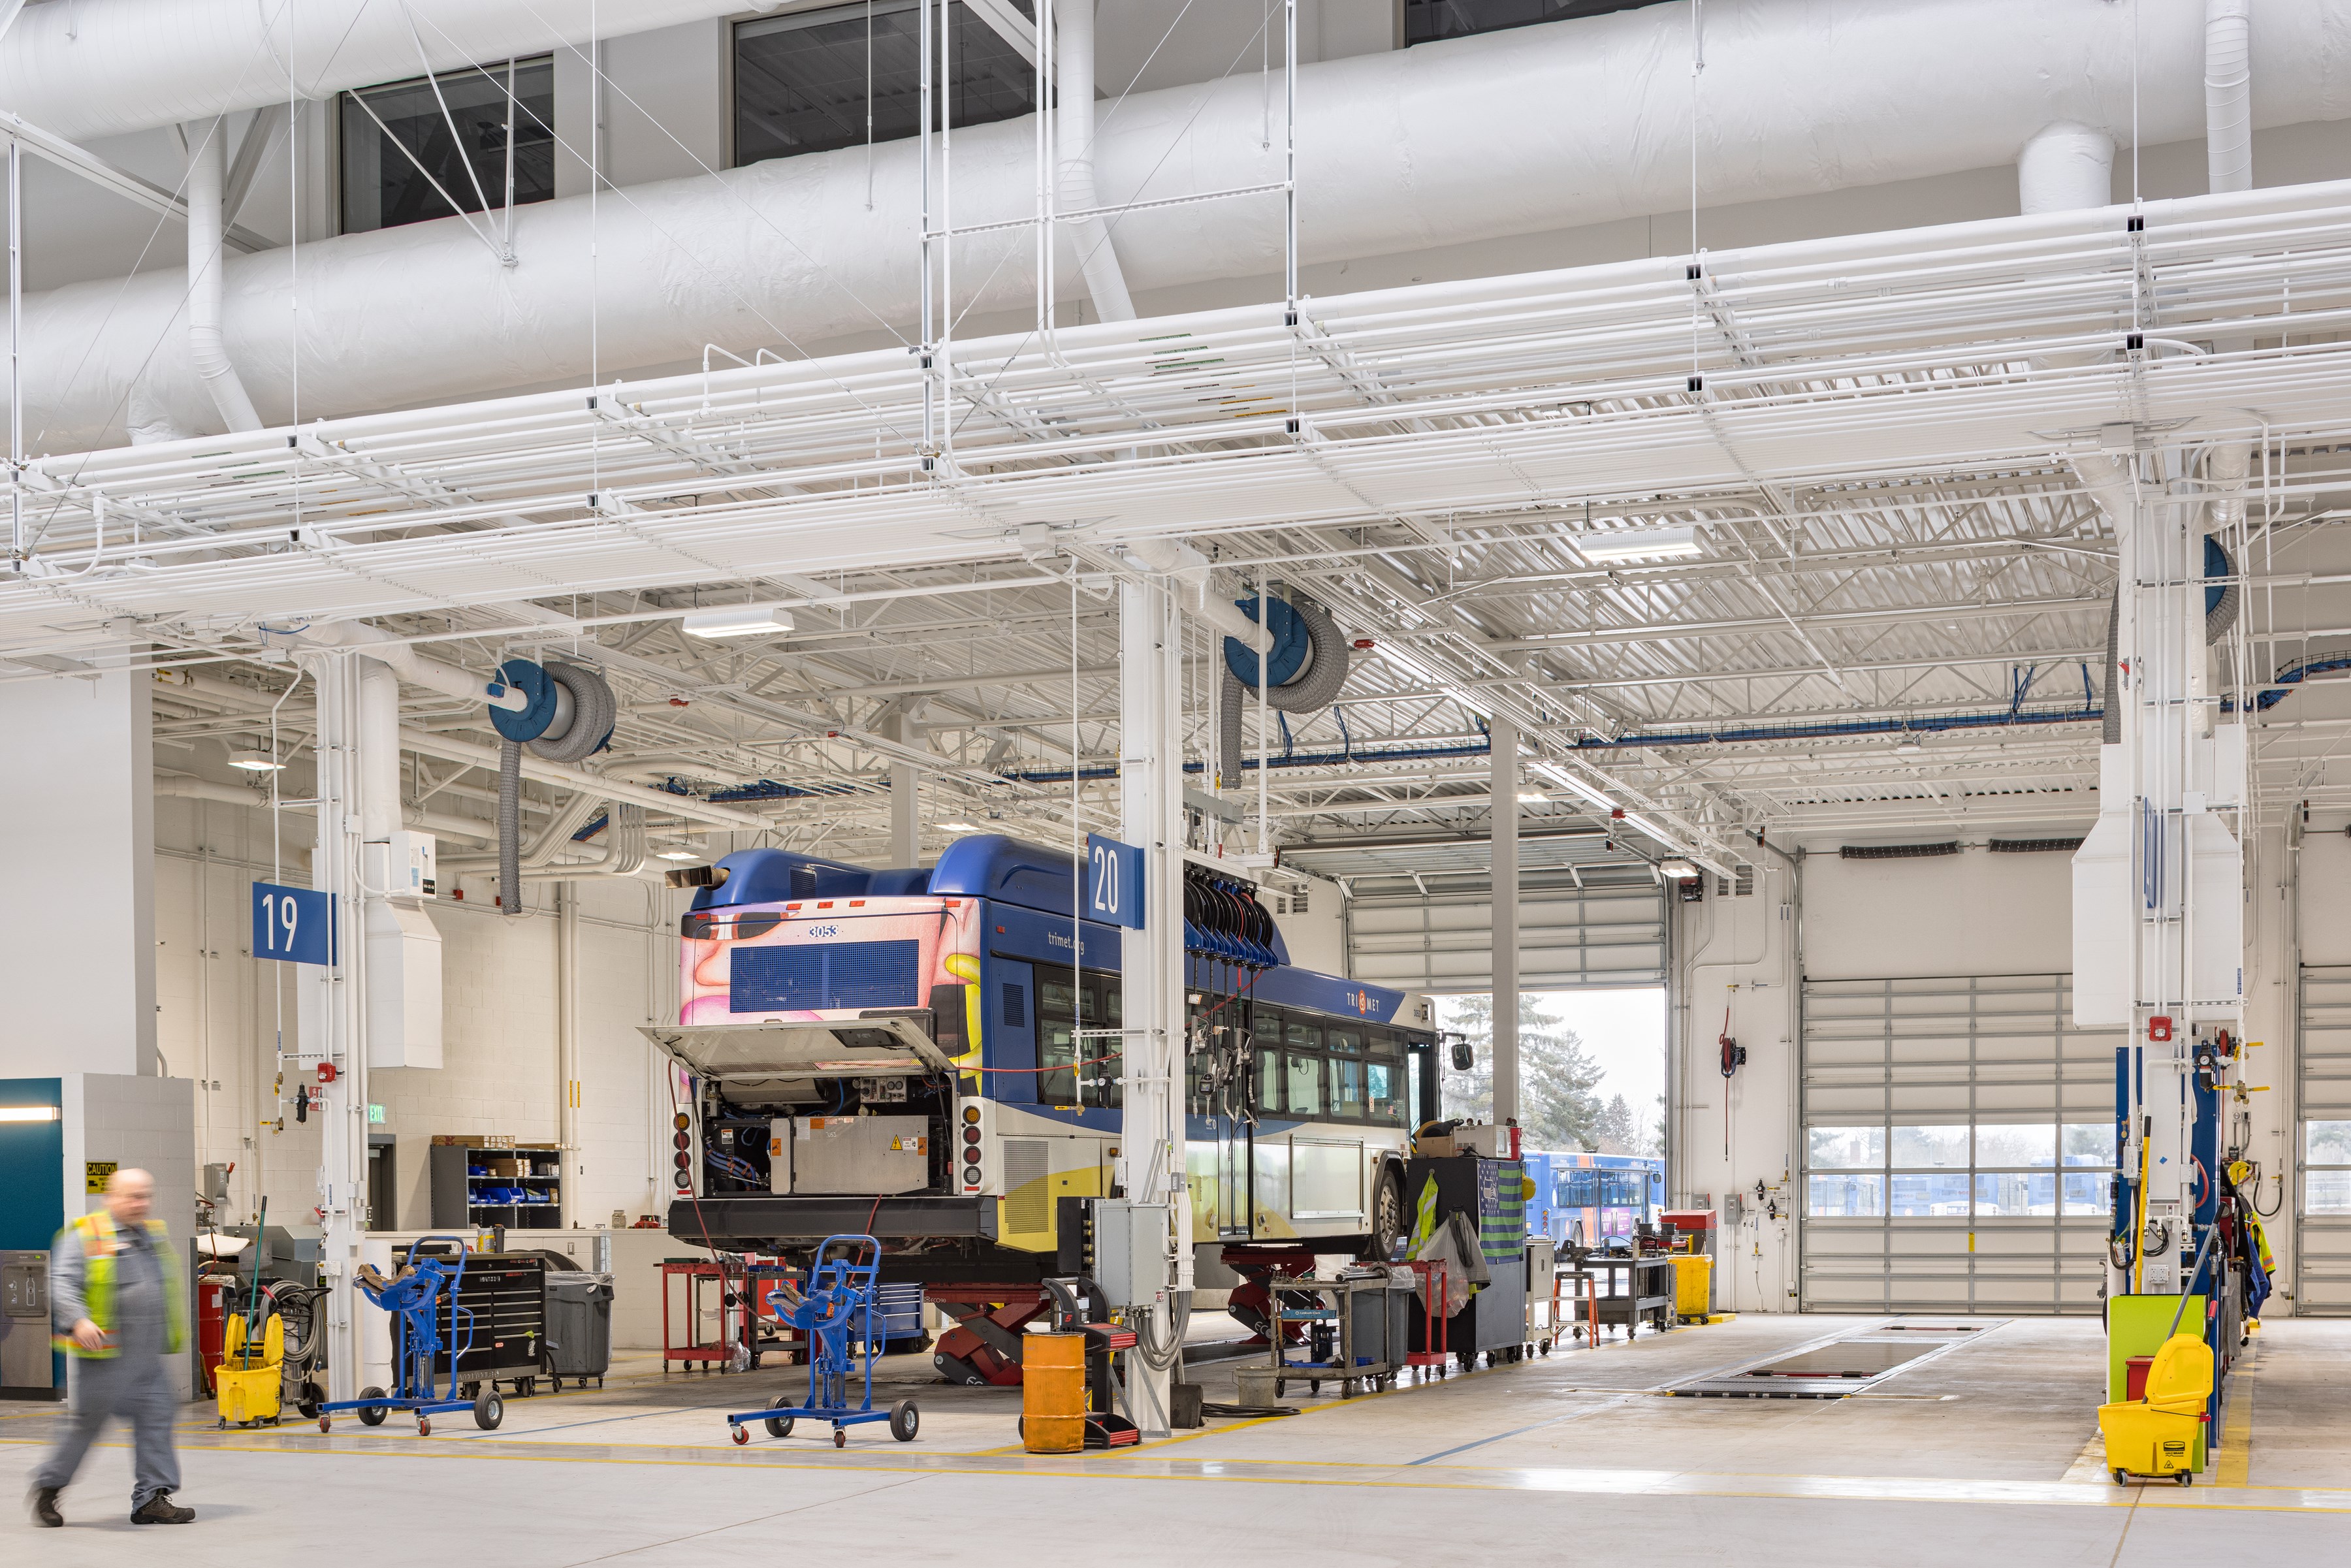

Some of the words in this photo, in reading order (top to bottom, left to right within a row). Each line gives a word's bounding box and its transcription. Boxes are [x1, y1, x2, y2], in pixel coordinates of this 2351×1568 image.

[1095, 846, 1118, 914] 20
[263, 893, 298, 952] 19
[809, 925, 839, 938] 3053
[370, 1104, 383, 1121] EXIT
[87, 1164, 117, 1175] CAUTION
